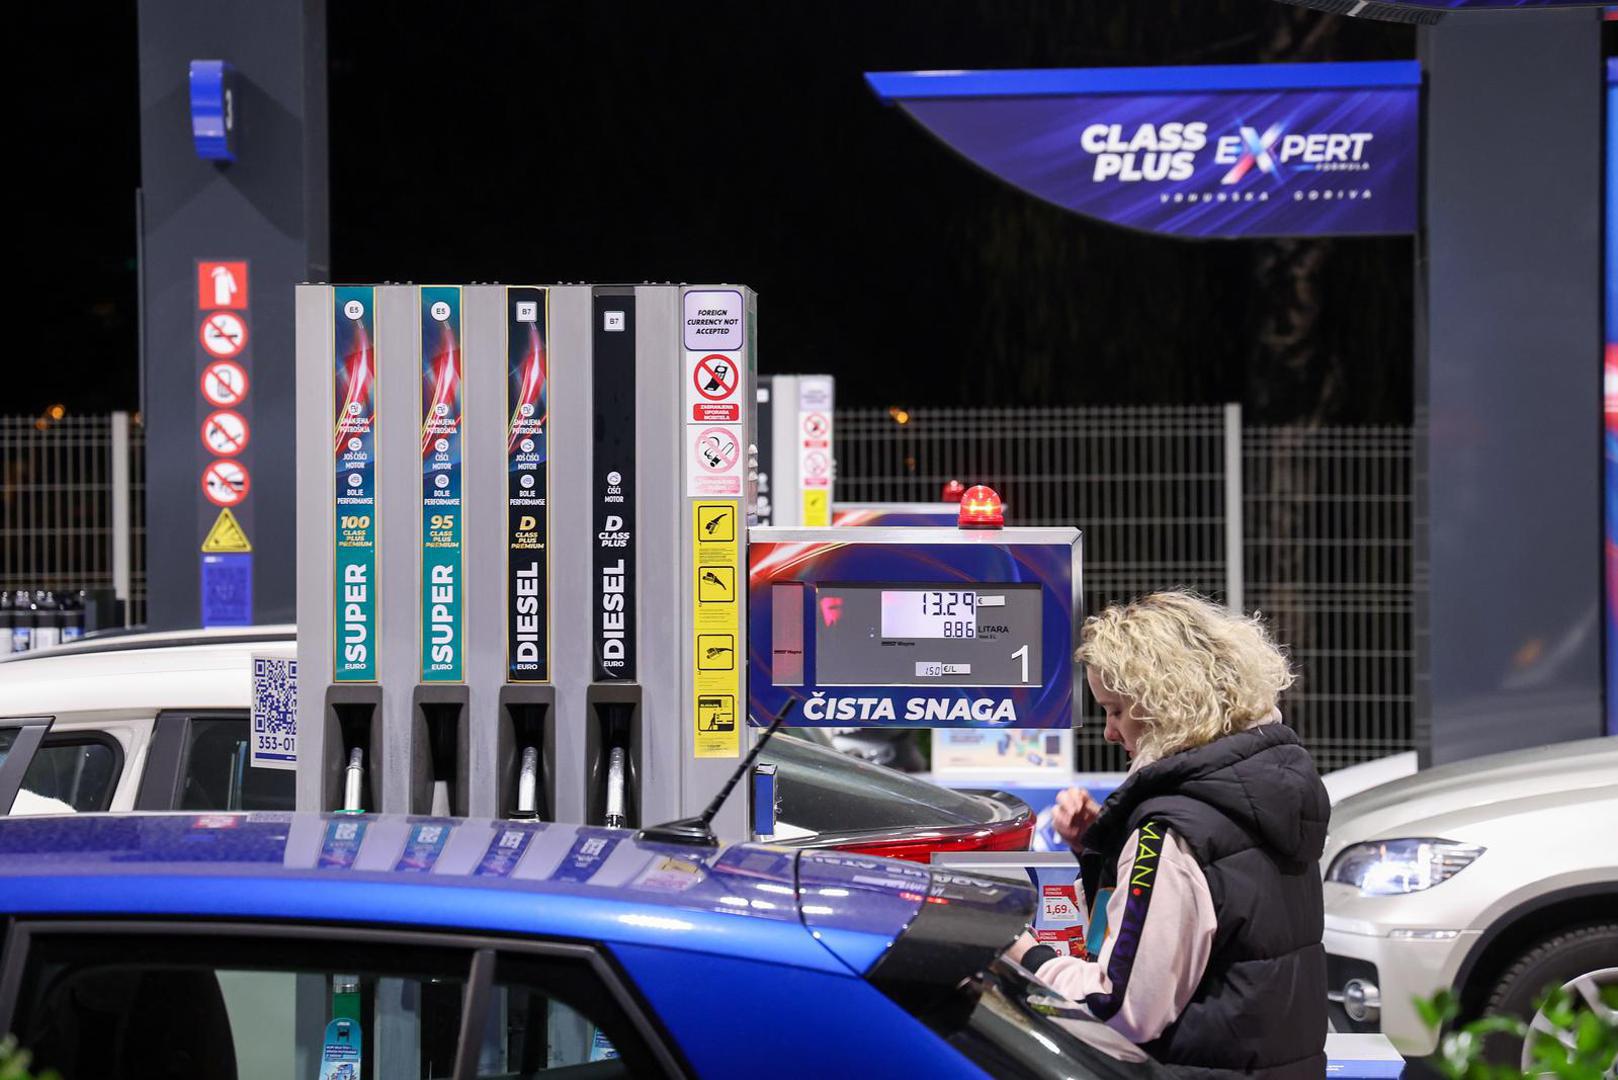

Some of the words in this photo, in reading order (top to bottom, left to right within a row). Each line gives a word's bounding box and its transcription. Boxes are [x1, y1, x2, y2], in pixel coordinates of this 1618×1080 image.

[1081, 122, 1207, 152] CLASS
[1214, 125, 1374, 184] EXPERT
[1092, 152, 1195, 182] PLUS
[1315, 162, 1370, 171] FORMULA
[1160, 191, 1269, 203] VRHUNSKA
[1294, 189, 1372, 201] GORIVA
[349, 306, 360, 314] E5
[340, 515, 370, 529] 100
[430, 514, 454, 529] 95
[519, 515, 537, 531] D
[604, 515, 623, 531] D
[598, 532, 630, 540] CLASS
[603, 559, 624, 659] DIESEL
[923, 592, 975, 616] 13.29
[977, 597, 984, 605] €
[344, 564, 367, 662] SUPER
[431, 565, 453, 663] SUPER
[517, 562, 538, 662] DIESEL
[943, 621, 974, 638] 8.86
[977, 625, 1009, 633] LITARA
[1011, 645, 1029, 683] 1
[803, 691, 896, 721] ČISTA
[904, 698, 1018, 722] SNAGA
[1046, 904, 1068, 915] 1,69
